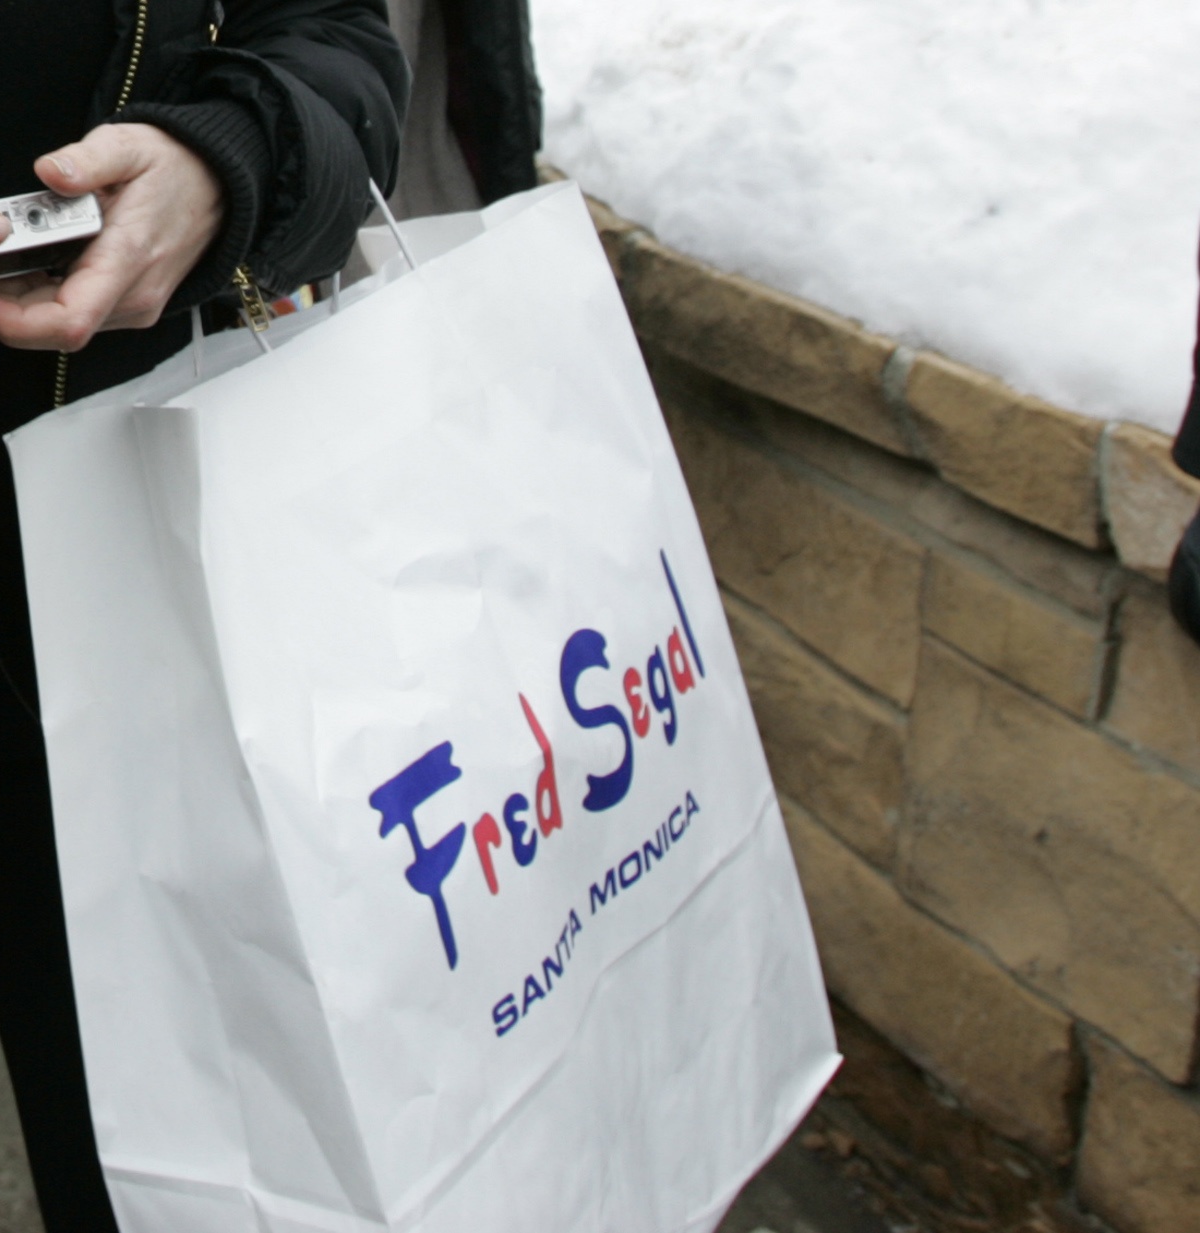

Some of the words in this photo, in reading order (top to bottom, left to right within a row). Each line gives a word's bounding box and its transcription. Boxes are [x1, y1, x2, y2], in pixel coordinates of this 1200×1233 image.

[369, 692, 563, 971] Fred
[559, 548, 705, 813] Segal
[492, 908, 583, 1037] SANTA
[589, 790, 701, 916] MONICA
